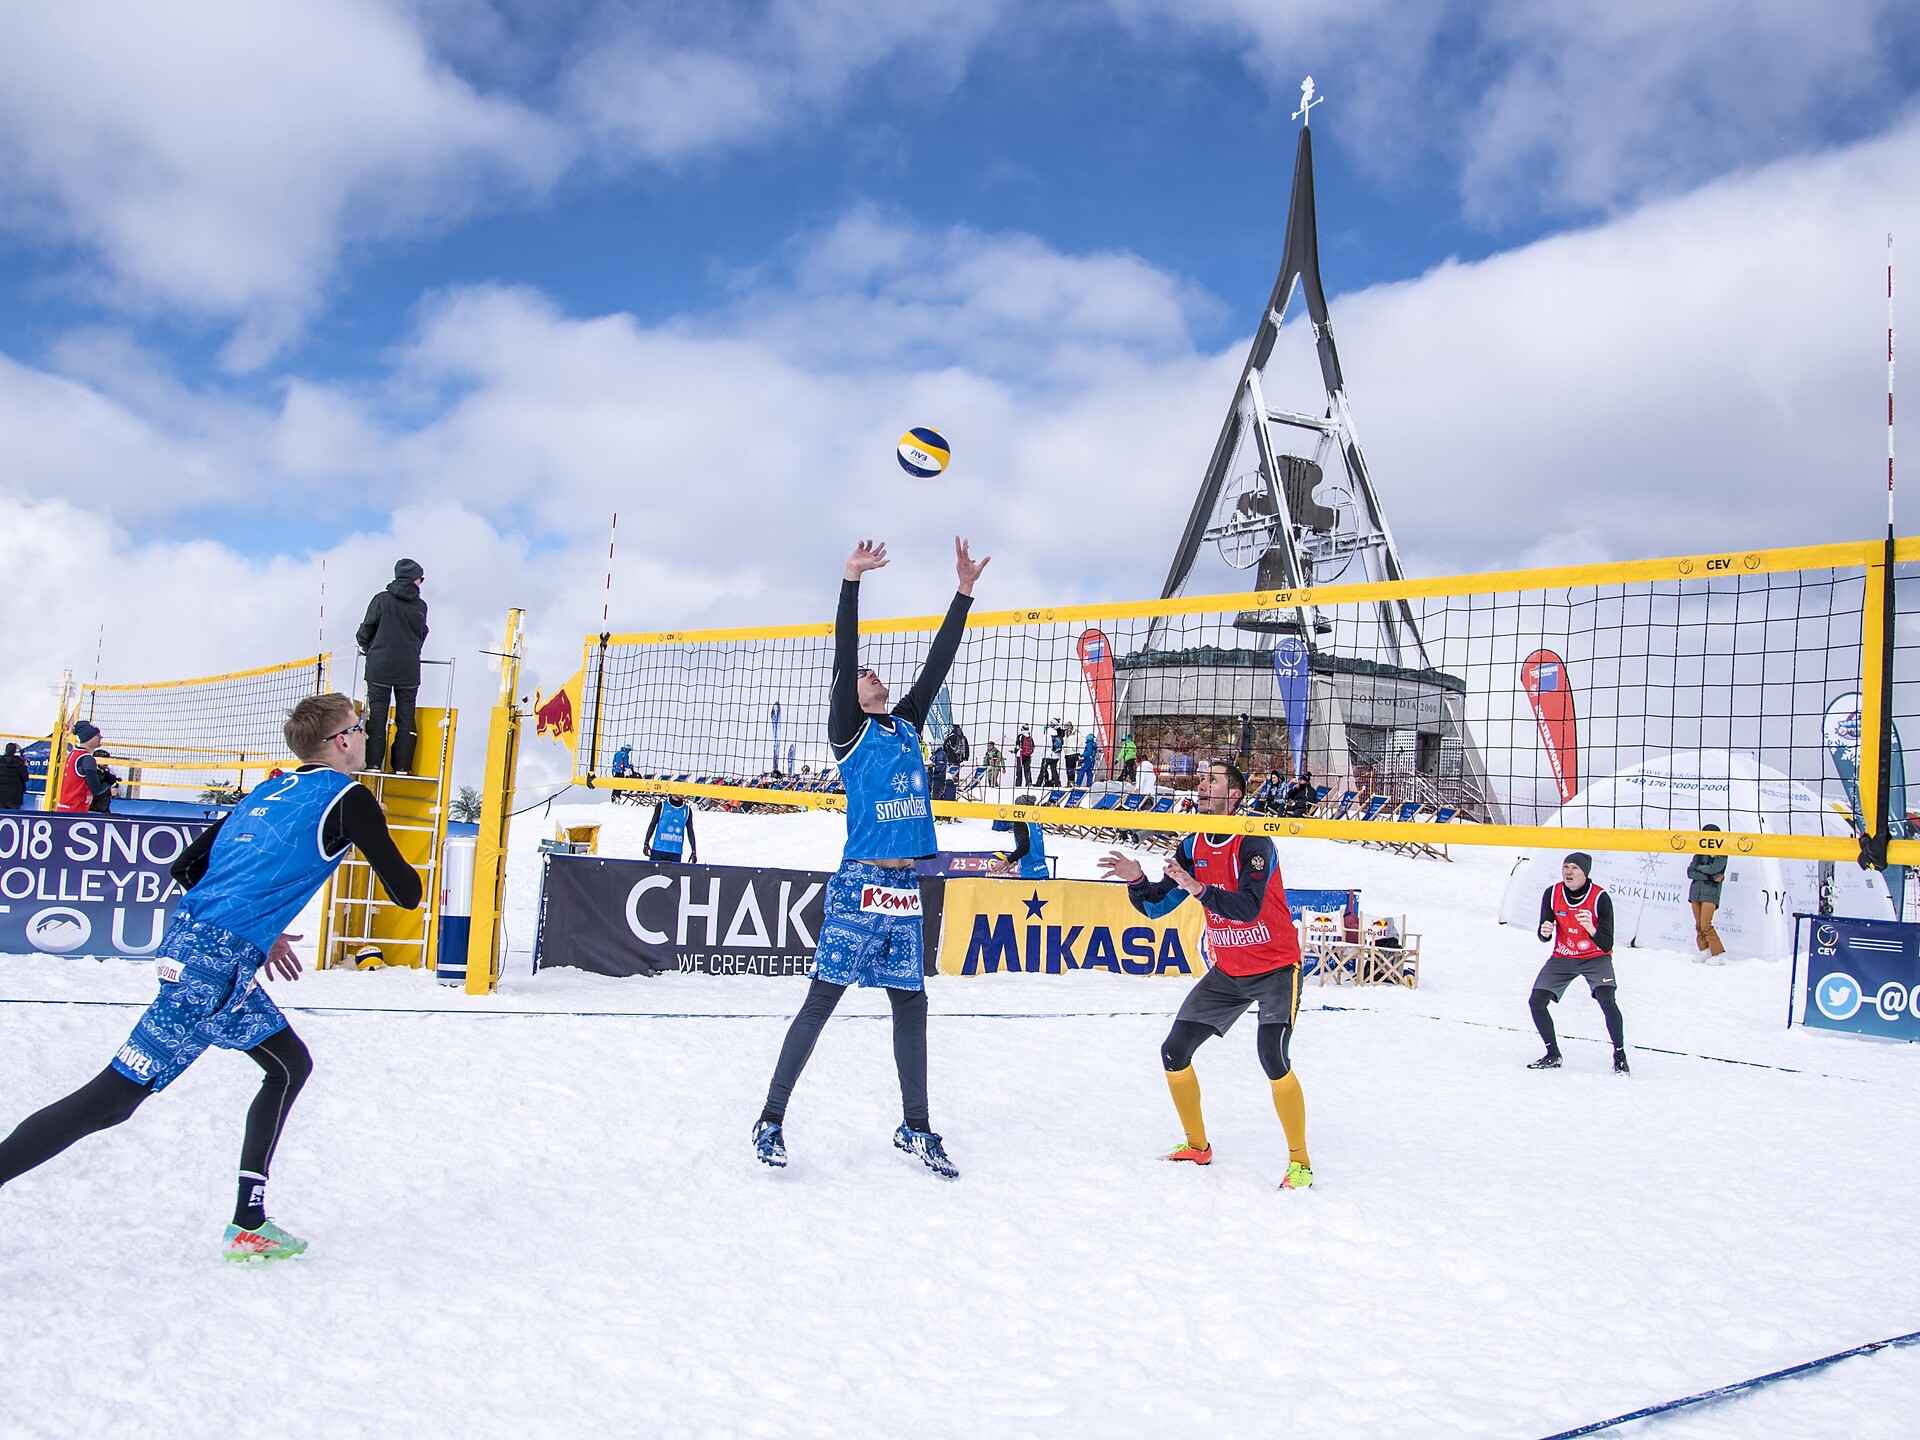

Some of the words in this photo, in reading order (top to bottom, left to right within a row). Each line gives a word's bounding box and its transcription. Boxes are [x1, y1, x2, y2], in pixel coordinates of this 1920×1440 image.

[1706, 558, 1732, 570] CEV
[1275, 592, 1293, 603] CEV
[1027, 611, 1041, 620] CEV
[1351, 694, 1417, 711] CONCORDIA
[1420, 702, 1437, 714] 2000
[263, 774, 299, 801] 2
[1648, 780, 1667, 788] 176
[1669, 781, 1699, 790] 2000
[1700, 783, 1730, 792] 2000
[825, 797, 836, 805] CEV
[249, 807, 270, 817] RUS
[1012, 809, 1027, 818] CEV
[1263, 823, 1281, 832] CEV
[1699, 838, 1724, 849] CEV
[953, 858, 967, 870] 23
[978, 860, 988, 871] 25
[0, 866, 188, 903] OLLEYBA
[1610, 876, 1641, 886] CHRISTA
[1608, 883, 1682, 904] SKIKLINIK
[1567, 927, 1579, 935] RUS
[1714, 925, 1743, 935] KIKLINIK
[961, 914, 1192, 975] MIKASA
[1817, 946, 1837, 956] CEV
[676, 953, 705, 974] WE
[710, 954, 779, 975] CREATE
